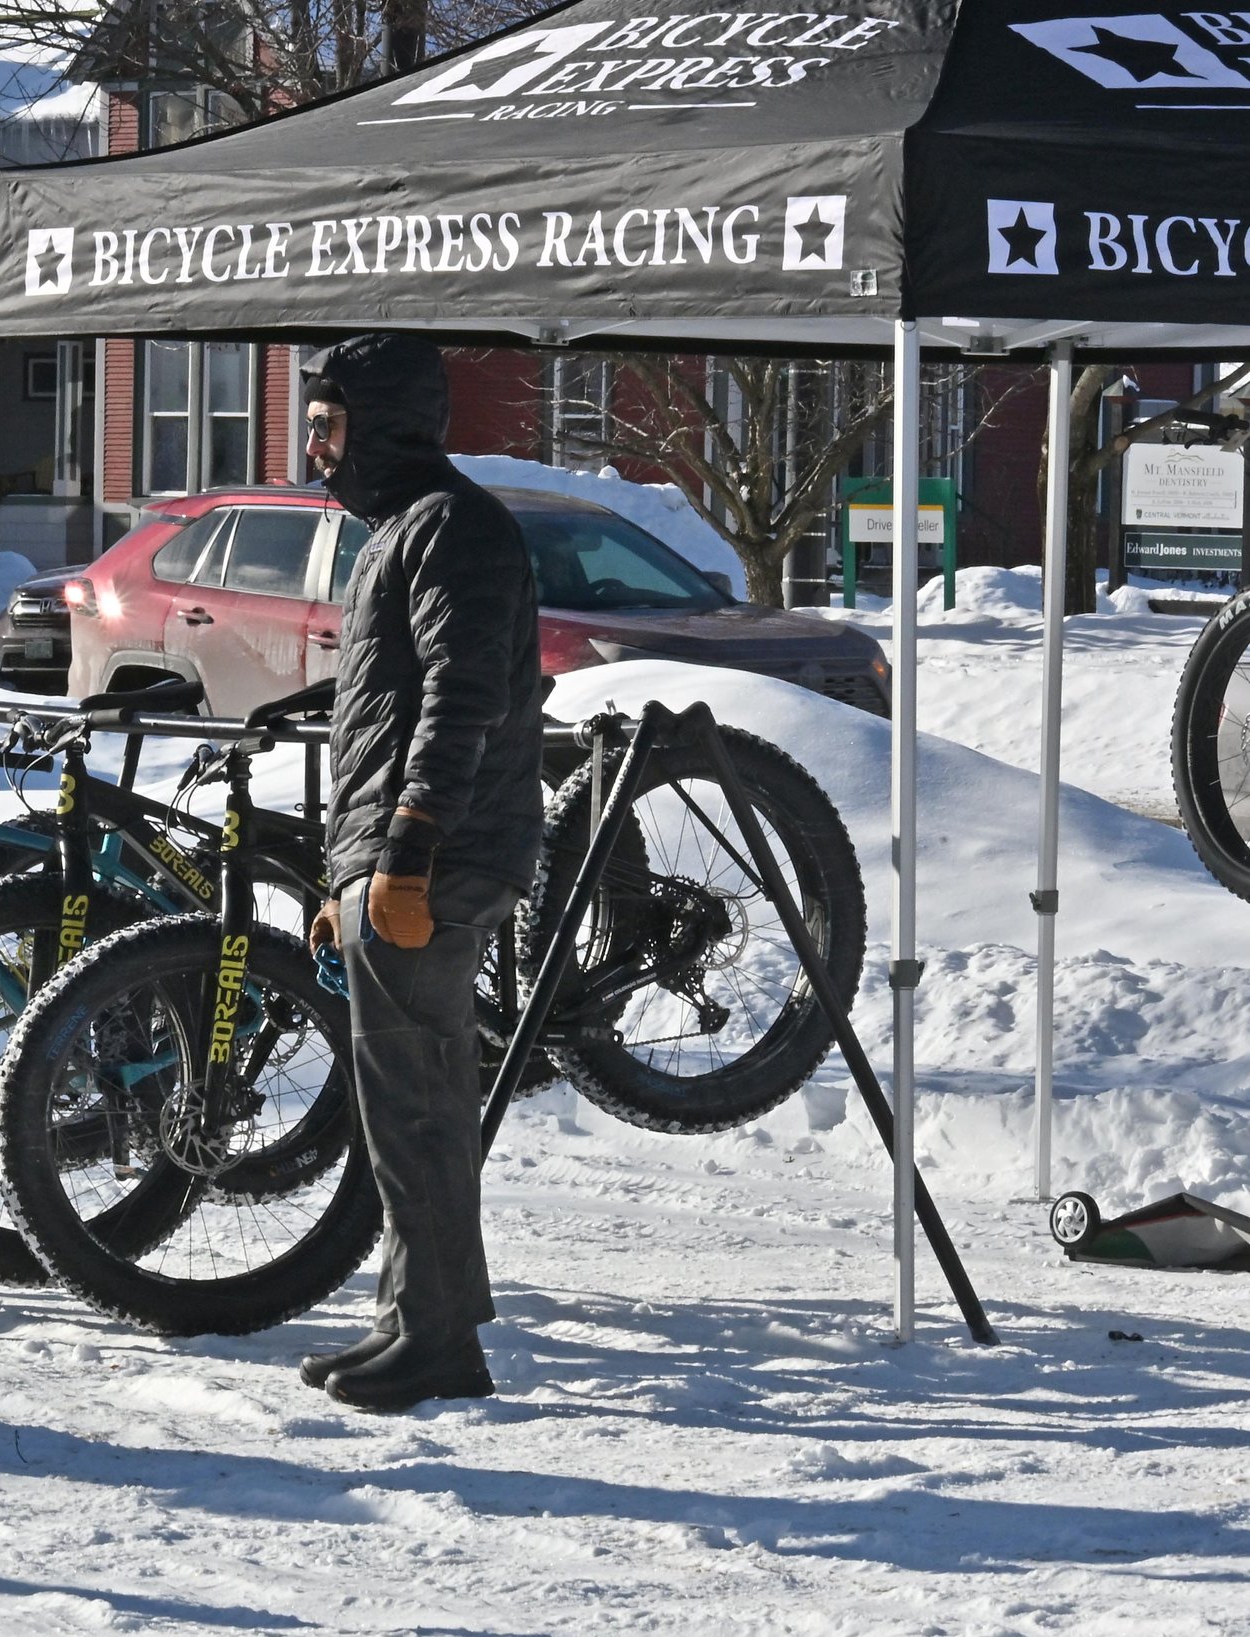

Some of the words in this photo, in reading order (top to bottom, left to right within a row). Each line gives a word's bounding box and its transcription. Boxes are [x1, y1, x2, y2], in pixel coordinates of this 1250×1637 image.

[587, 13, 900, 52] BICYCLE
[536, 56, 831, 95] EXPRESS
[480, 100, 617, 121] RACING
[87, 222, 294, 287] BICYCLE
[304, 212, 521, 277] EXPRESS
[536, 205, 761, 267] RACING
[1083, 211, 1250, 277] BICY
[1158, 478, 1208, 488] DENTISTRY
[1169, 464, 1225, 478] MANSFIELD
[916, 519, 940, 532] eller
[1192, 546, 1243, 557] INVESTMENTS
[1218, 594, 1250, 630] MA
